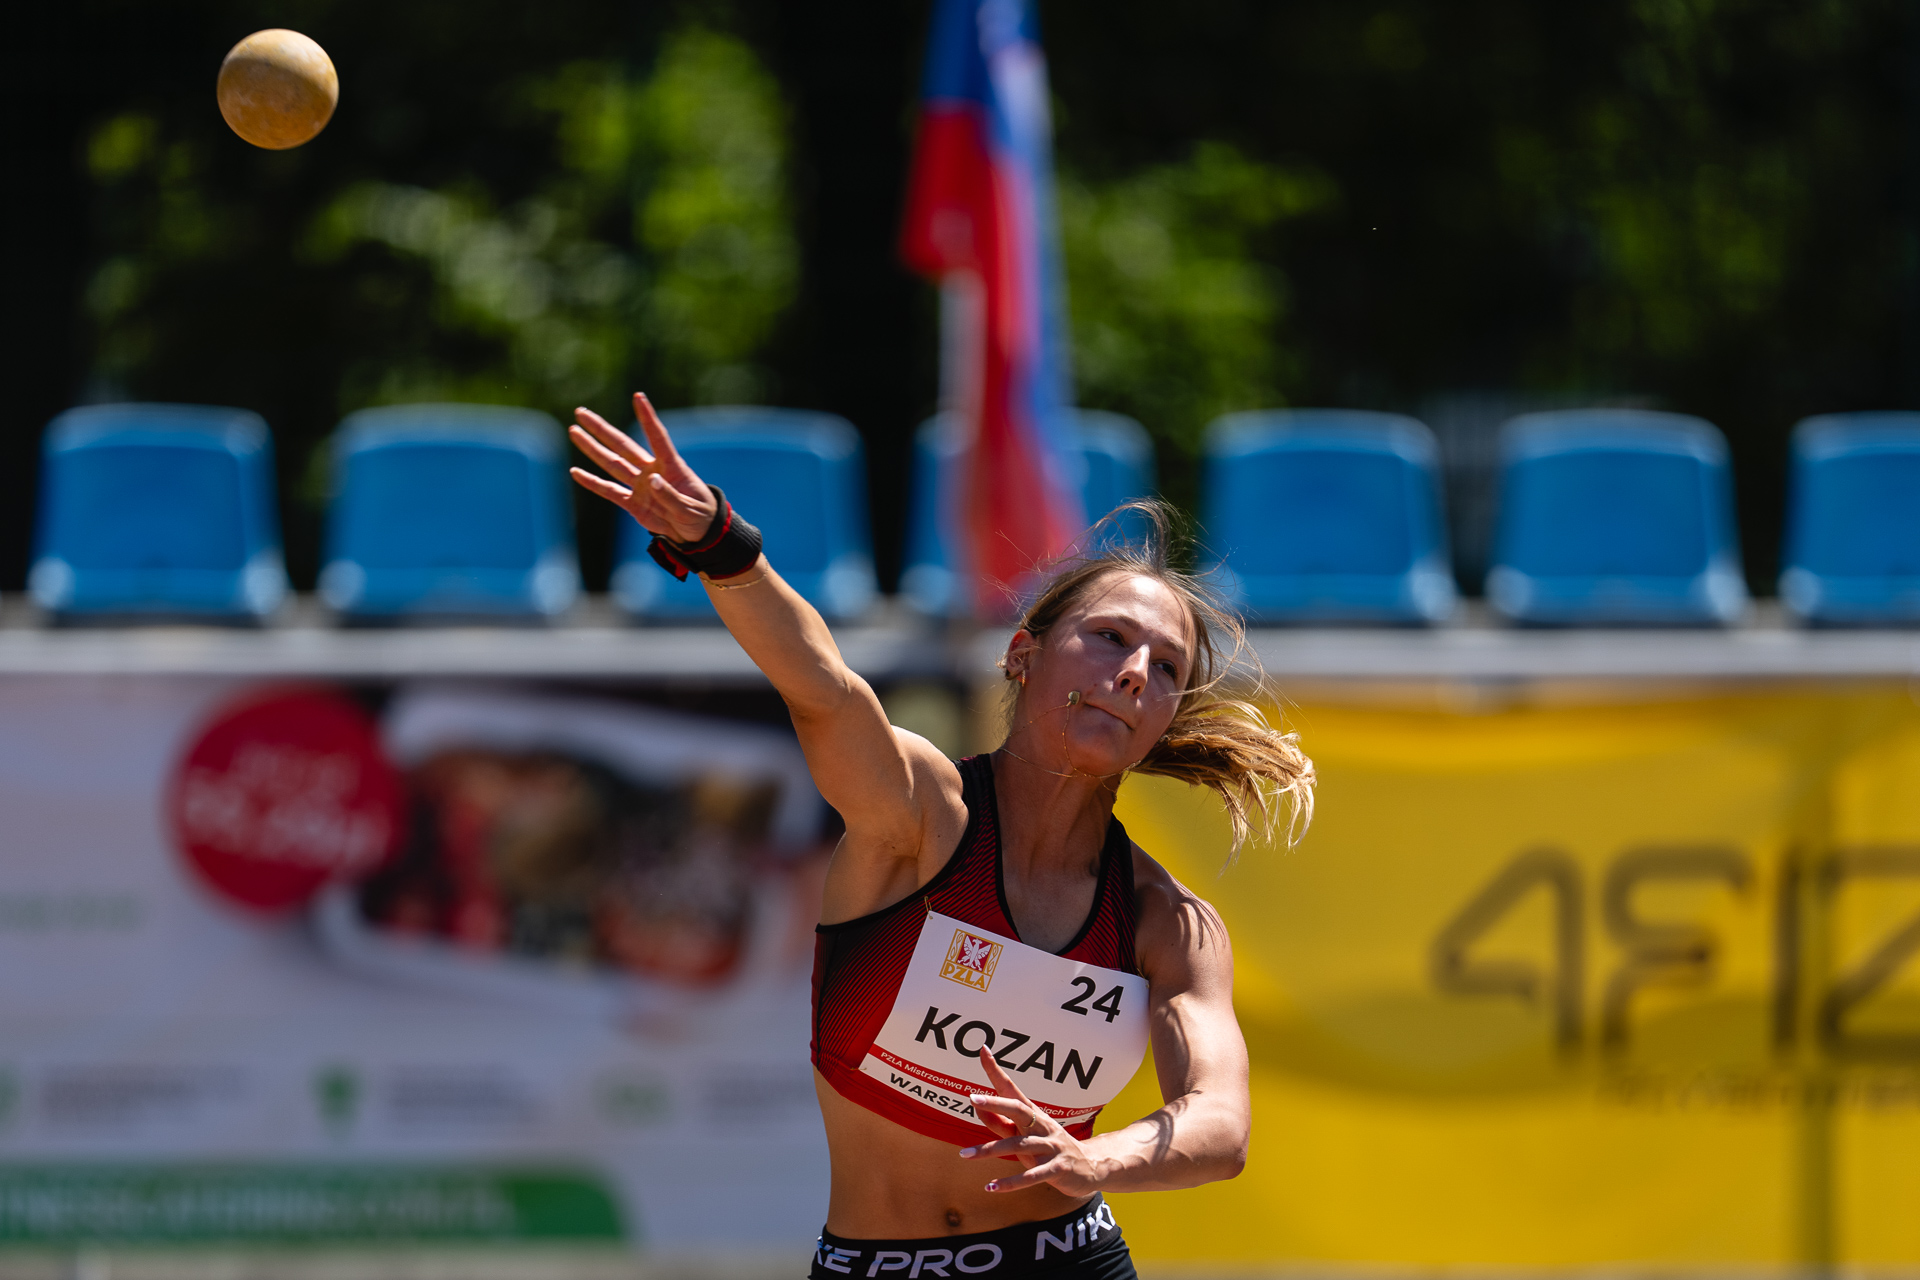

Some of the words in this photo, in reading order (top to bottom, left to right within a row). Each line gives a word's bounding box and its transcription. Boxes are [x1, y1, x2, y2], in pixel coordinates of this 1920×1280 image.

[942, 962, 986, 989] PZLA
[1061, 975, 1125, 1024] 24
[914, 1005, 1104, 1091] KOZAN
[889, 1072, 976, 1118] WARSZA
[904, 1063, 963, 1090] Mistrzostwa
[866, 1243, 1003, 1279] PRO
